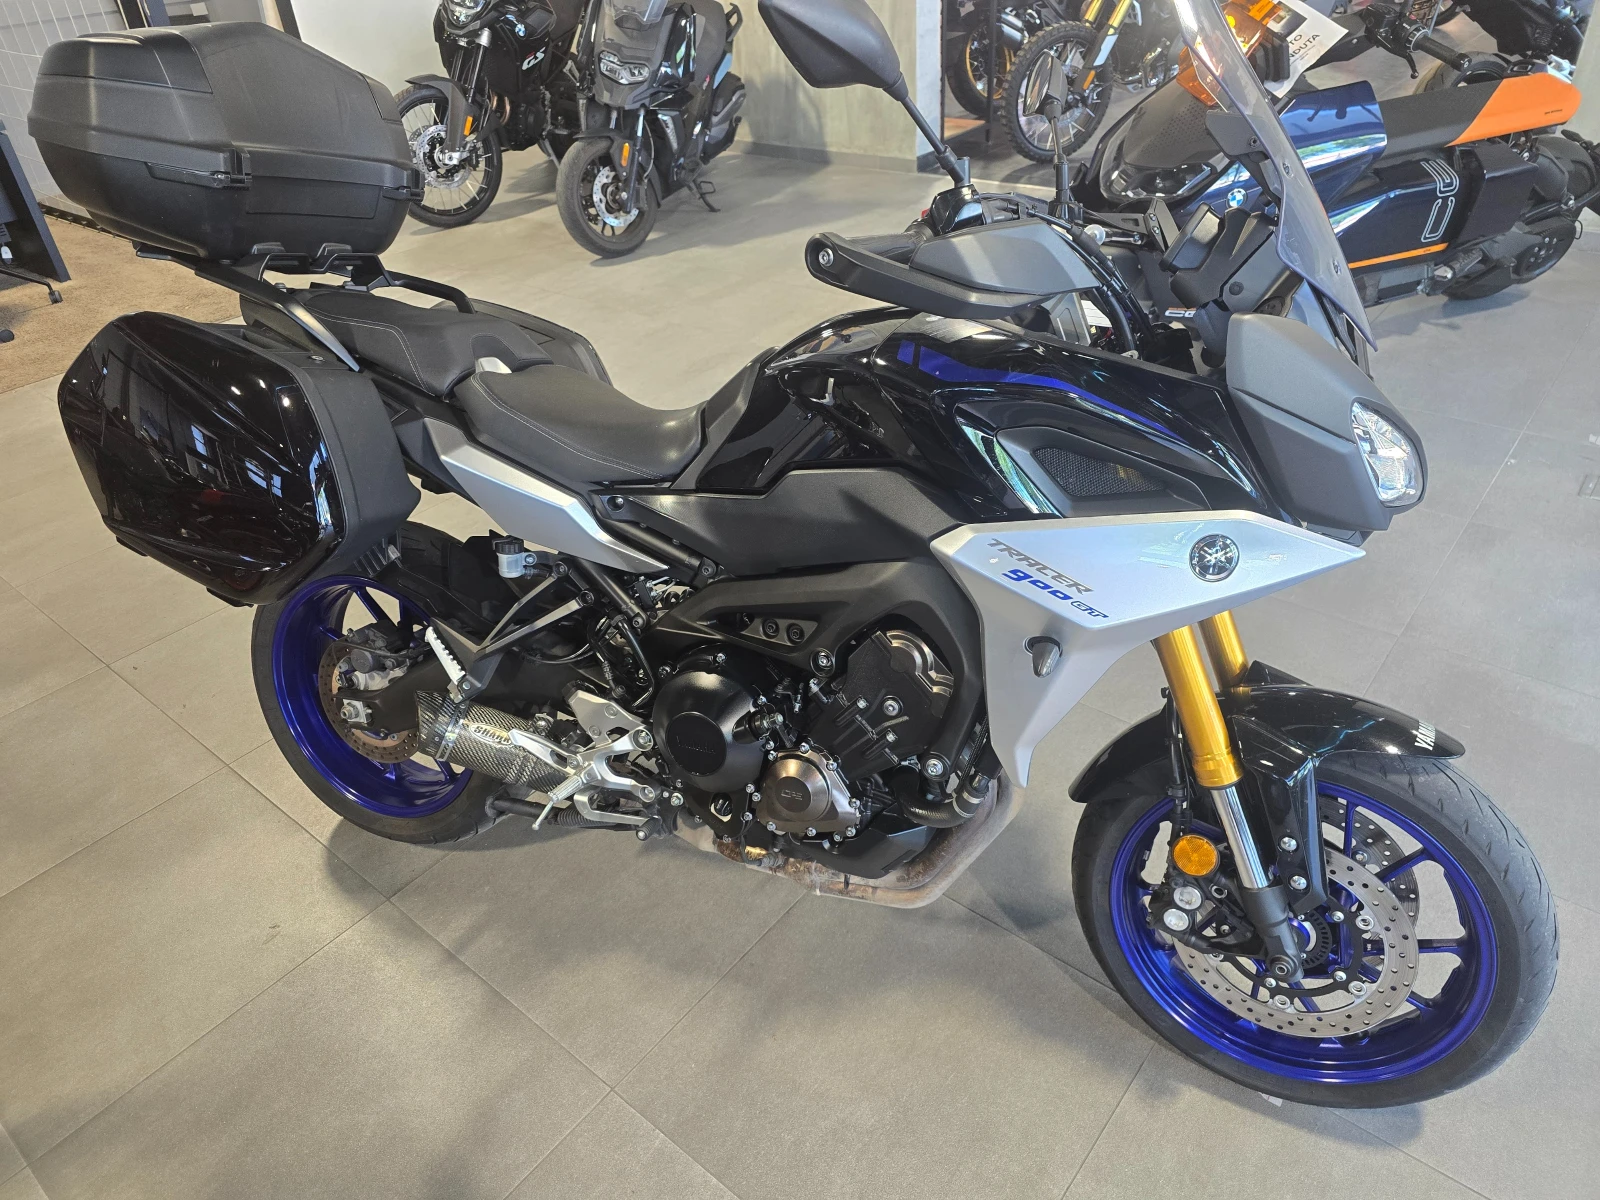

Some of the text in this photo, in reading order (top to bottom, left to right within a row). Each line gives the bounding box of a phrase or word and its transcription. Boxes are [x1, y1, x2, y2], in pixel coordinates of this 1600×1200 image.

[521, 46, 546, 70] GS
[1289, 34, 1320, 58] NDUTA
[987, 538, 1094, 595] TRACER
[1002, 568, 1109, 619] 900 GT
[473, 725, 511, 744] SHARK
